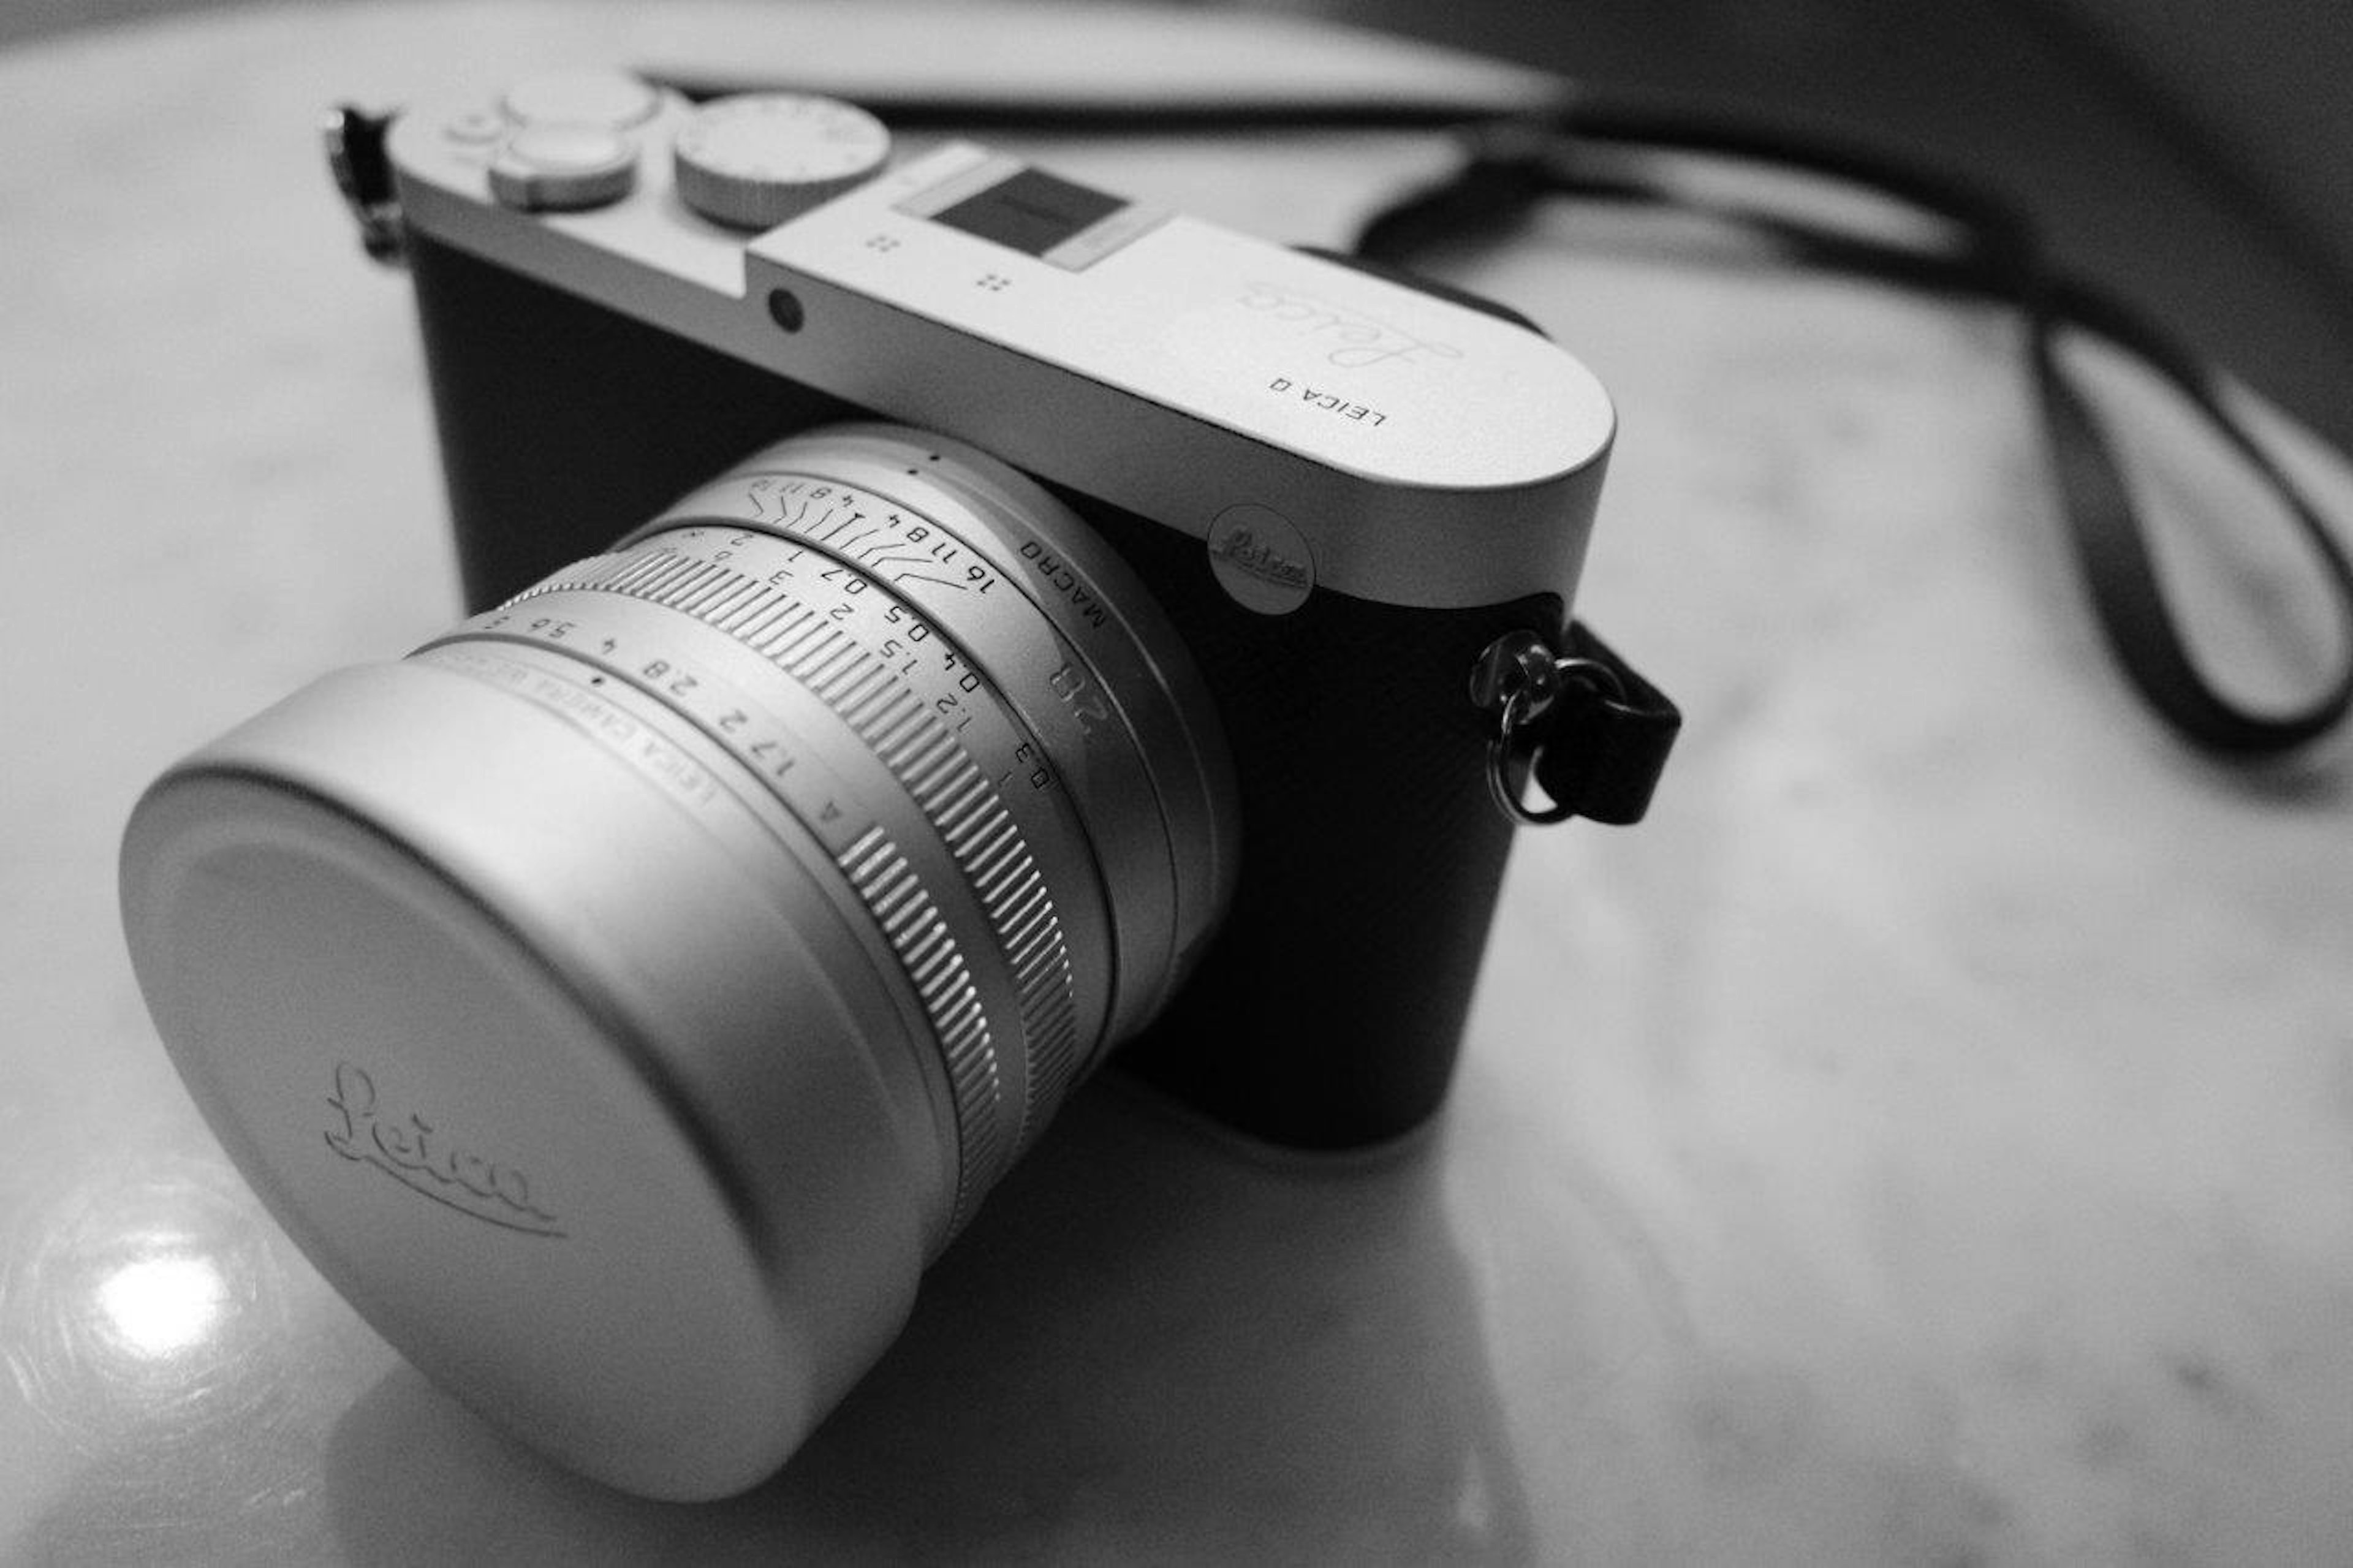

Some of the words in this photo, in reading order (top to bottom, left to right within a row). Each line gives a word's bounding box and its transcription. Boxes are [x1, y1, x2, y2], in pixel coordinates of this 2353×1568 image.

[1303, 388, 1387, 427] LEICA
[730, 532, 755, 547] 2
[787, 550, 804, 562] 1
[809, 488, 832, 499] 8
[842, 494, 854, 508] 4
[889, 514, 901, 528] 4
[906, 527, 930, 543] 8
[931, 542, 957, 564] 11
[966, 566, 995, 594] 16
[768, 570, 795, 585] 3
[820, 569, 868, 595] 0.7
[1020, 541, 1105, 629] MACRO
[829, 602, 855, 621] 2
[884, 605, 930, 642] 0.5
[602, 638, 616, 655] 4
[879, 639, 919, 675] 1.5
[944, 652, 980, 693] 0.4
[936, 693, 972, 733] 1.2
[1049, 662, 1108, 735] 28
[718, 708, 749, 735] 2
[1015, 743, 1050, 790] 0.3
[818, 800, 844, 824] A
[323, 1061, 569, 1240] Leica
